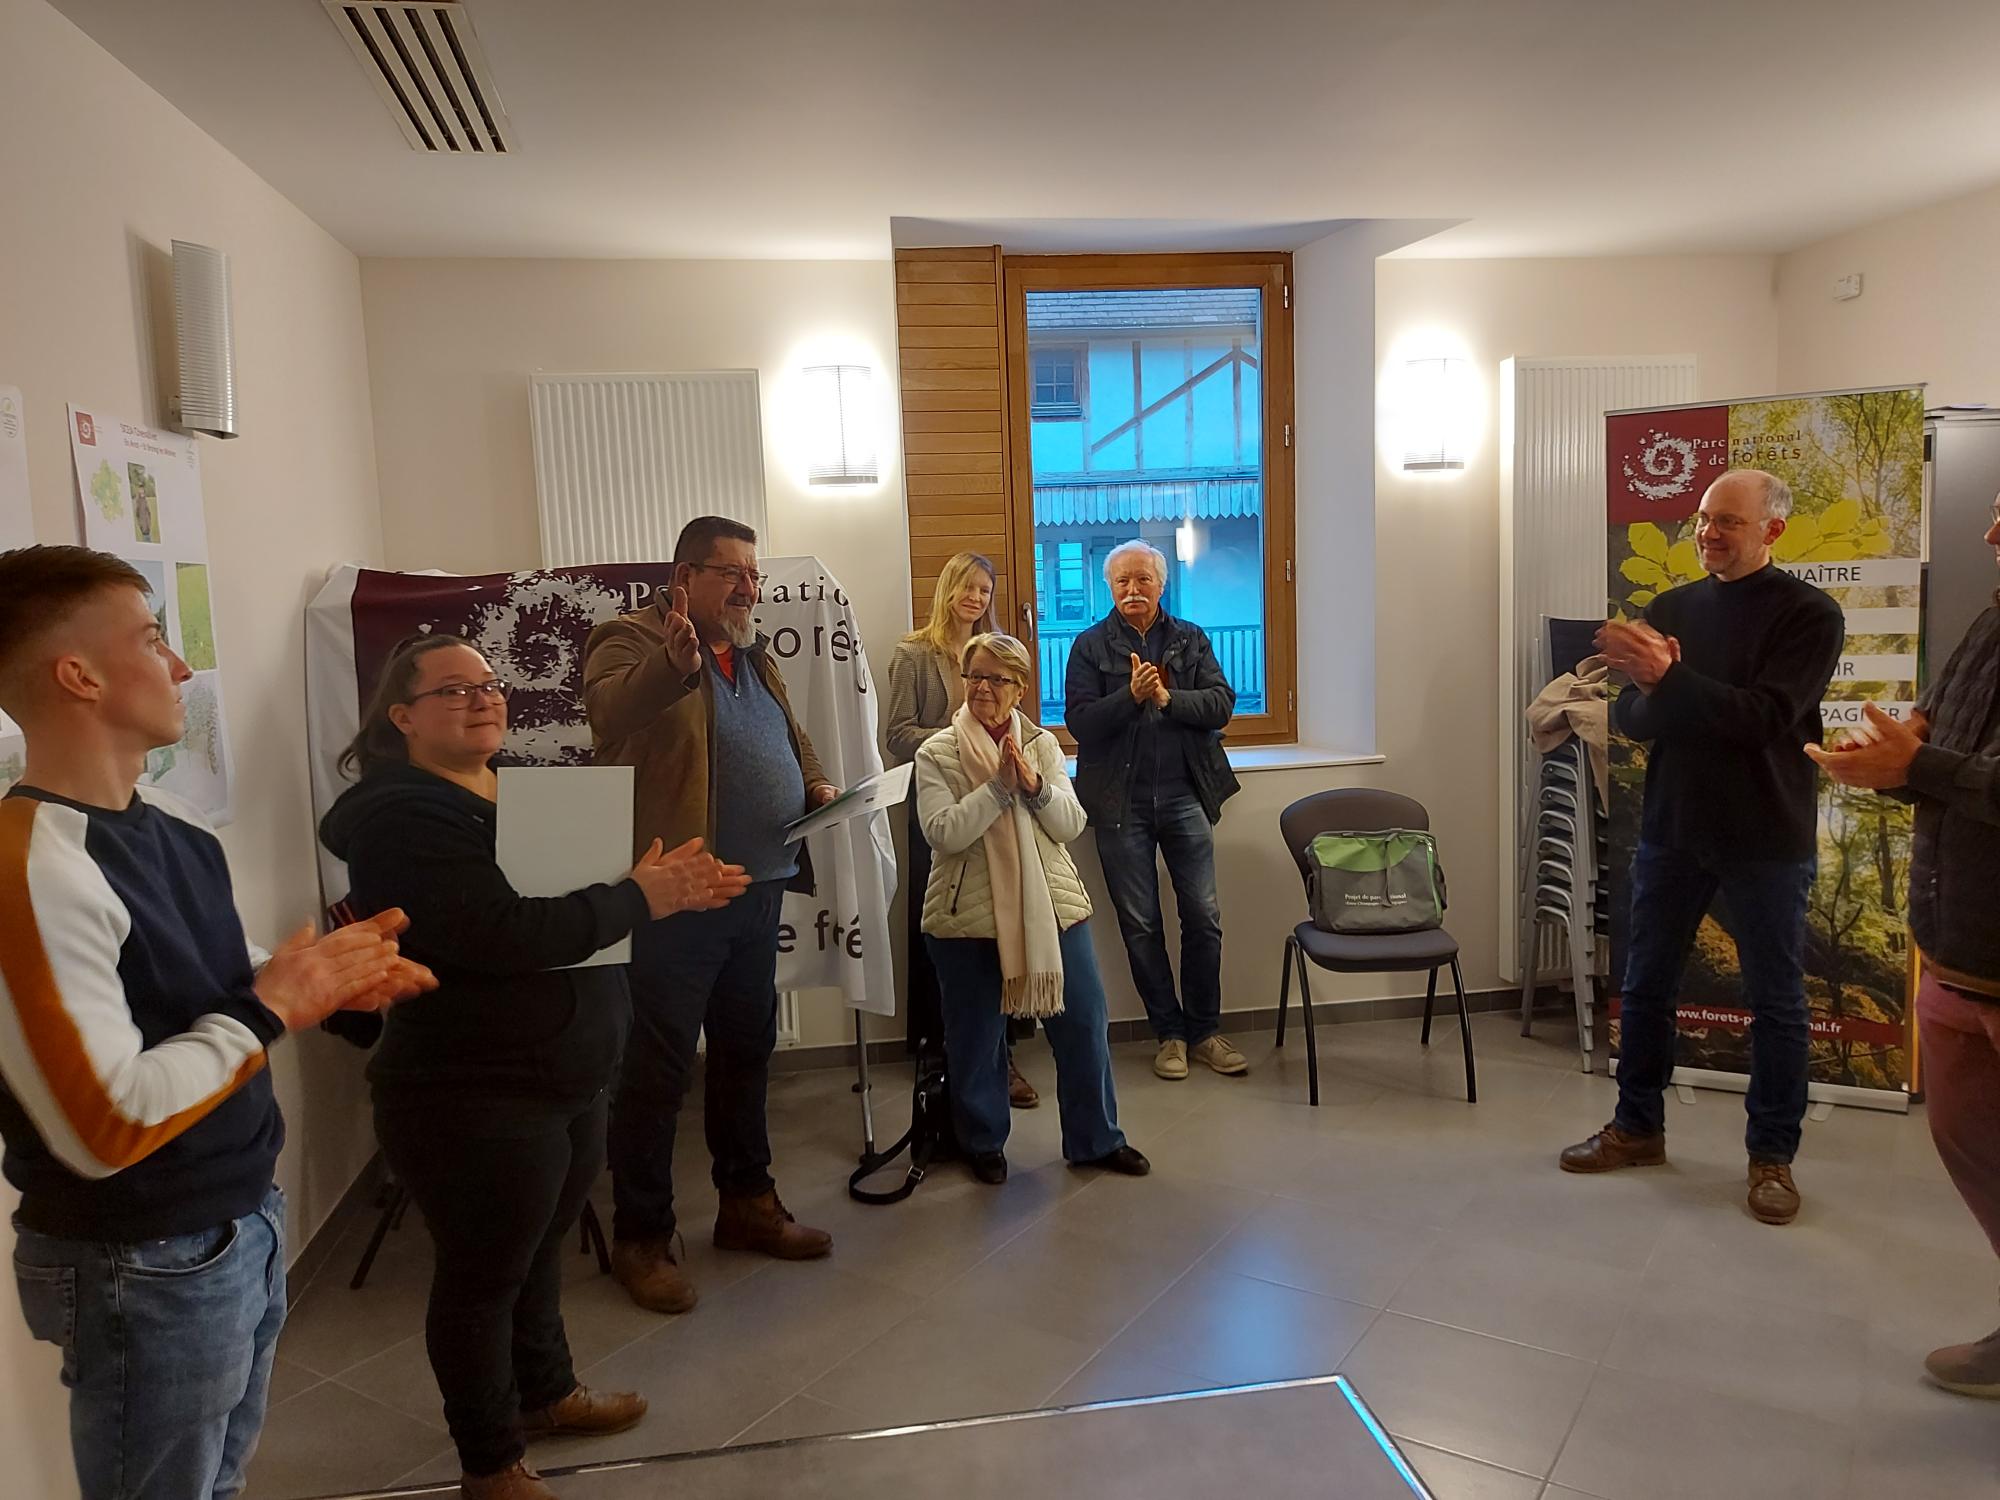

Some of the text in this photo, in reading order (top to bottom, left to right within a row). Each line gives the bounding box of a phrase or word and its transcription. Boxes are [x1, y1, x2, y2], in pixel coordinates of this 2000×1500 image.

[1693, 430, 1802, 449] Parc national
[1709, 446, 1801, 466] de forêts
